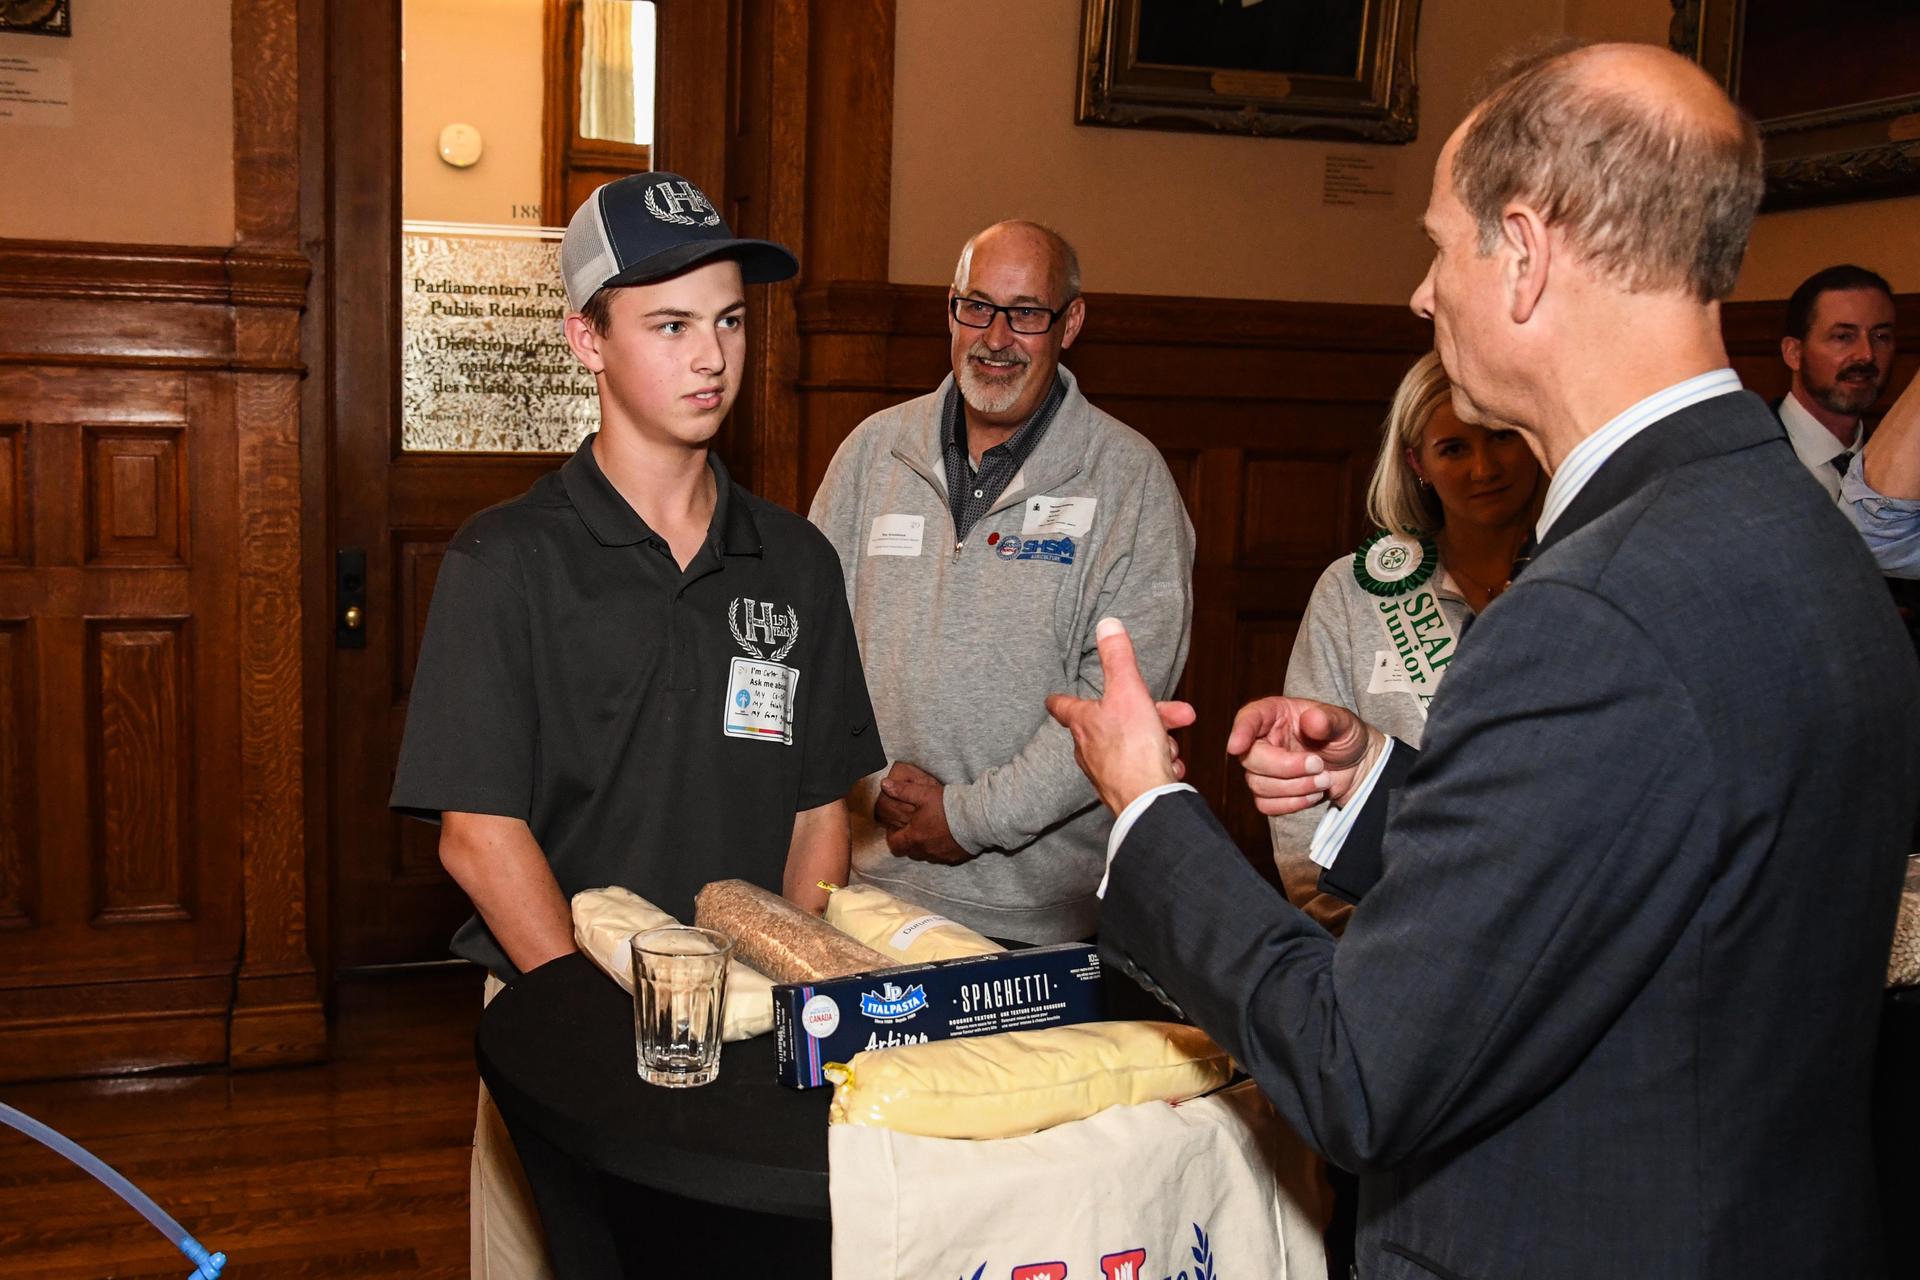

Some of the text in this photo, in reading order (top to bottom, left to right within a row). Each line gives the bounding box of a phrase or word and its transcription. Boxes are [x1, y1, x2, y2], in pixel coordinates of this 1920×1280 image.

[656, 181, 704, 214] H
[414, 278, 567, 299] Parliamentary Pro
[431, 301, 564, 319] Public Relations
[544, 342, 571, 356] pro
[433, 379, 599, 399] des relations publiqu
[772, 614, 788, 627] 150
[772, 626, 790, 638] YEARS
[1379, 600, 1426, 684] Junior
[751, 667, 762, 675] I'm
[750, 678, 762, 687] Ask
[774, 682, 787, 690] abou
[961, 973, 1050, 1013] SPAGHETTI
[867, 996, 921, 1015] ITALPASTA
[809, 1013, 833, 1024] CANADA
[865, 1030, 929, 1051] Artisan
